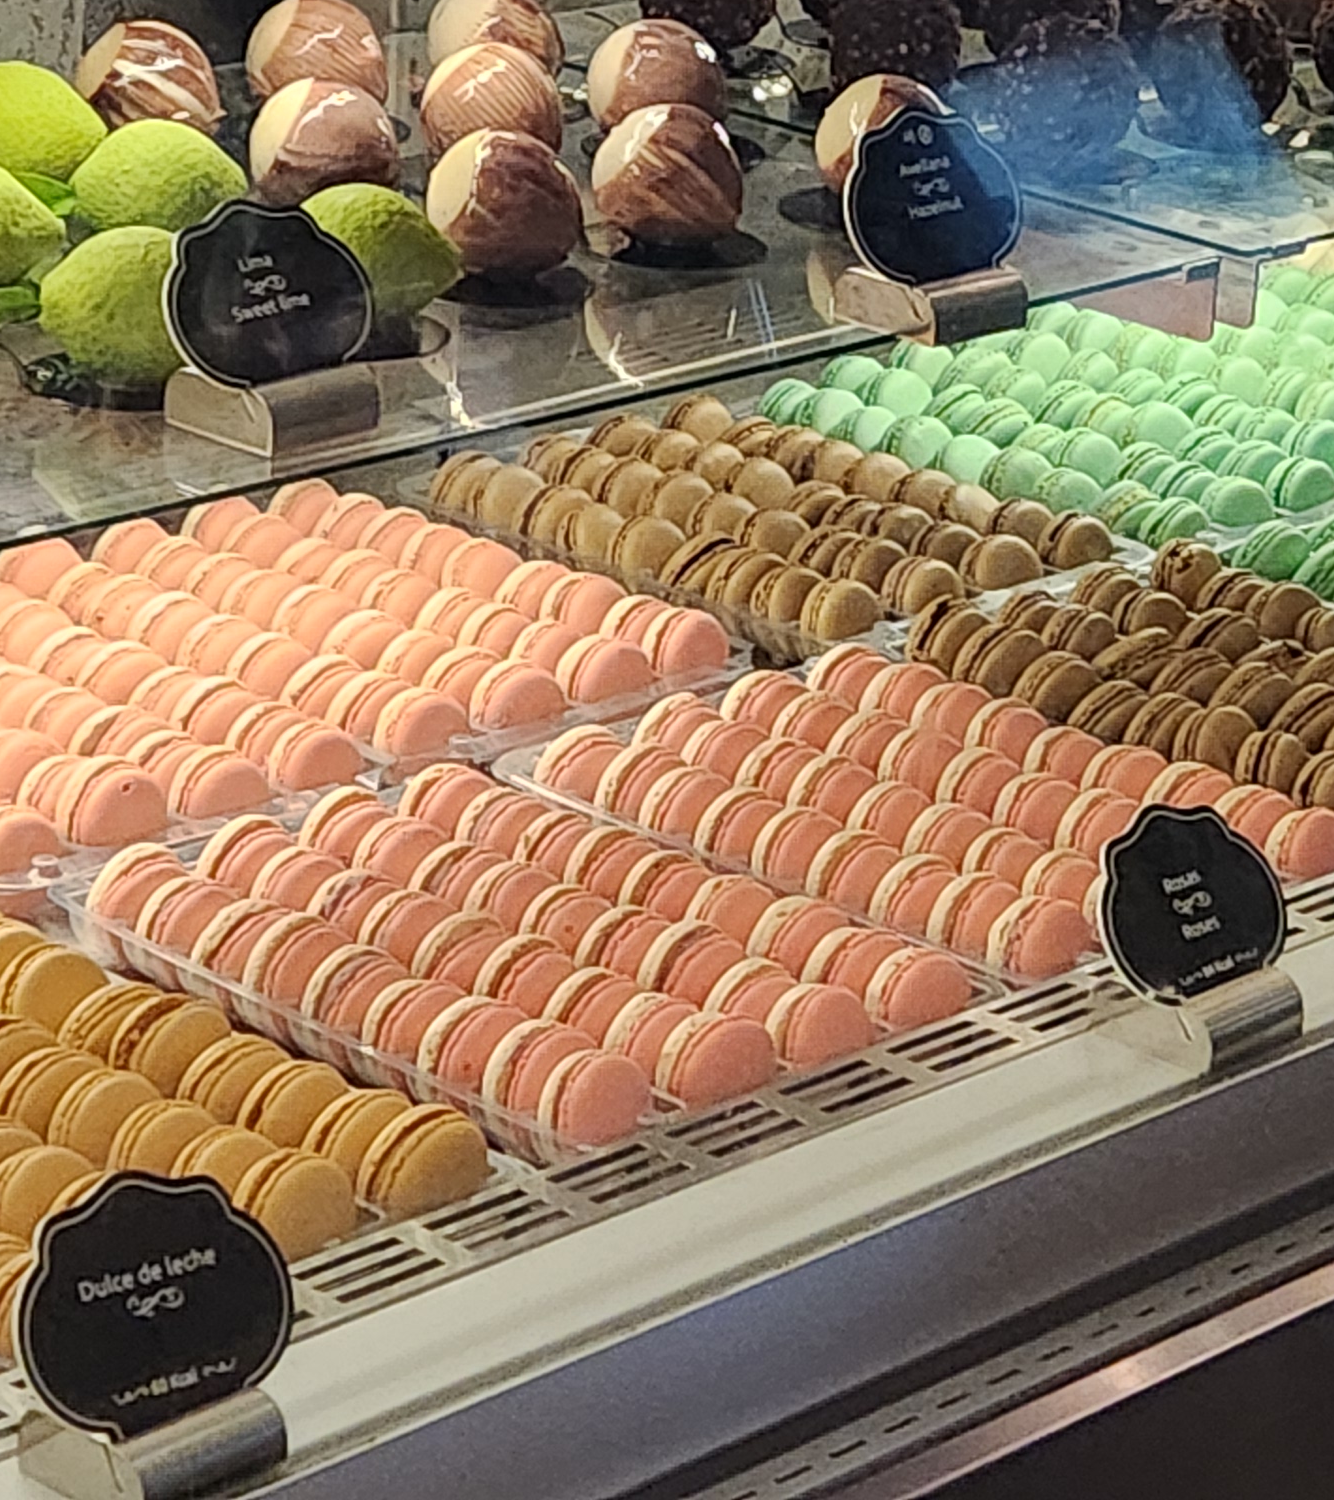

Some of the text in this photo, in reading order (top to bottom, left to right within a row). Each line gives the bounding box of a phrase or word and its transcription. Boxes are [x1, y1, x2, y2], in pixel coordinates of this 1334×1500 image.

[78, 1248, 217, 1303] Dulce de leche
